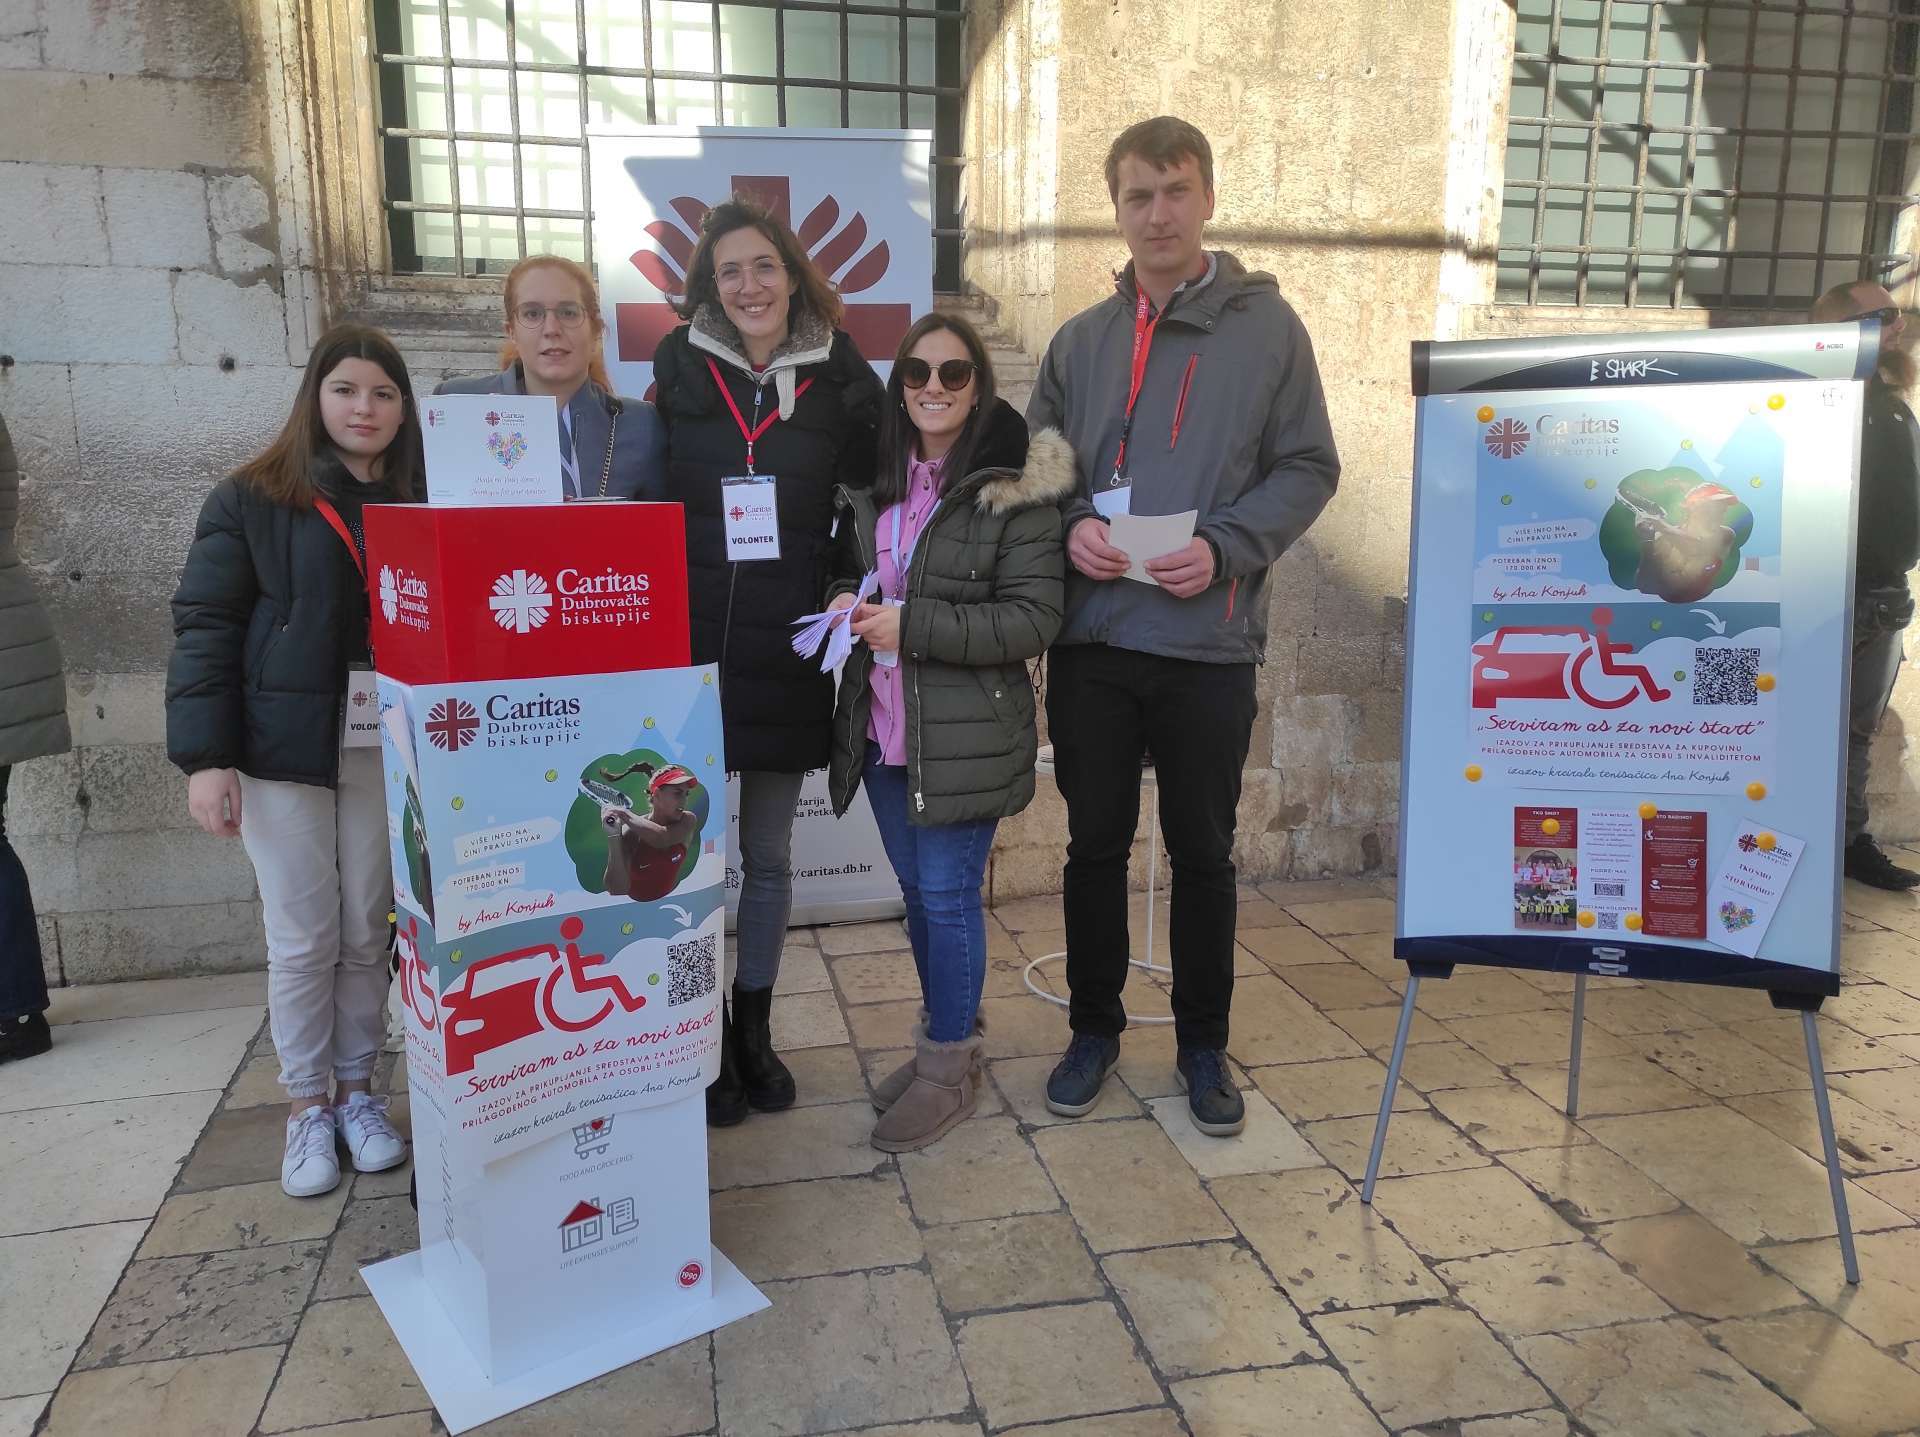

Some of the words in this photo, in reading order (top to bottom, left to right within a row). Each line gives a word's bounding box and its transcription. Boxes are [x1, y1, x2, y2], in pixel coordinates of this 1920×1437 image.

[1605, 358, 1679, 379] SHARK
[1536, 412, 1620, 435] Caitas
[1526, 534, 1551, 542] PRAVU
[1533, 526, 1552, 534] INFO
[731, 535, 774, 545] VOLONTER
[396, 568, 428, 599] Caritas
[556, 567, 650, 595] Caritas
[1493, 586, 1506, 601] by
[1511, 586, 1538, 598] Ana
[1541, 583, 1587, 600] Konjuh
[560, 593, 650, 611] Dubrovačke
[400, 610, 430, 632] biskupije
[561, 608, 651, 627] biskupije
[486, 692, 580, 721] Caritas
[350, 723, 380, 731] VOLON
[487, 717, 581, 735] Dubrovačke
[1586, 719, 1612, 733] as
[1615, 721, 1643, 733] za
[1649, 721, 1695, 735] novi
[487, 729, 581, 748] biskupije
[1549, 741, 1614, 749] PRIKUPLJANJE
[1691, 744, 1742, 752] KUPOVINU
[1560, 750, 1620, 758] AUTOMOBILA
[1686, 753, 1761, 761] INVALIDITETOM
[1507, 766, 1546, 776] izazov
[1660, 769, 1684, 780] Ana
[1689, 770, 1731, 784] Konjuh
[807, 808, 848, 817] Petko
[463, 848, 481, 858] ČINI
[484, 841, 512, 851] PRAVU
[515, 834, 541, 845] STVAR
[470, 837, 488, 846] VIŠE
[491, 831, 512, 841] INFO
[453, 871, 491, 886] POTREBAN
[458, 915, 472, 933] by
[475, 909, 502, 925] Ana
[505, 893, 555, 917] Konjuh
[562, 1042, 588, 1061] as
[592, 1038, 620, 1054] za
[626, 1025, 672, 1046] novi
[478, 1095, 513, 1114] IZAZOV
[515, 1091, 527, 1099] ZA
[529, 1066, 592, 1094] PRIKUPLJANJE
[595, 1055, 650, 1071] SREDSTAVA
[654, 1052, 666, 1060] ZA
[669, 1038, 708, 1056] KUPOVINU
[541, 1075, 599, 1100] AUTOMOBILA
[602, 1071, 615, 1079] ZA
[619, 1065, 652, 1076] OSOBU
[664, 1040, 718, 1068] INVALIDITETOM
[493, 1124, 532, 1144] izazov
[533, 1101, 577, 1128] kreirala
[579, 1088, 638, 1110] tenisačica
[640, 1082, 665, 1094] Ana
[667, 1066, 701, 1089] Konjuh
[559, 1171, 579, 1182] FOOD
[580, 1165, 596, 1177] AND
[681, 1270, 698, 1281] 1990
